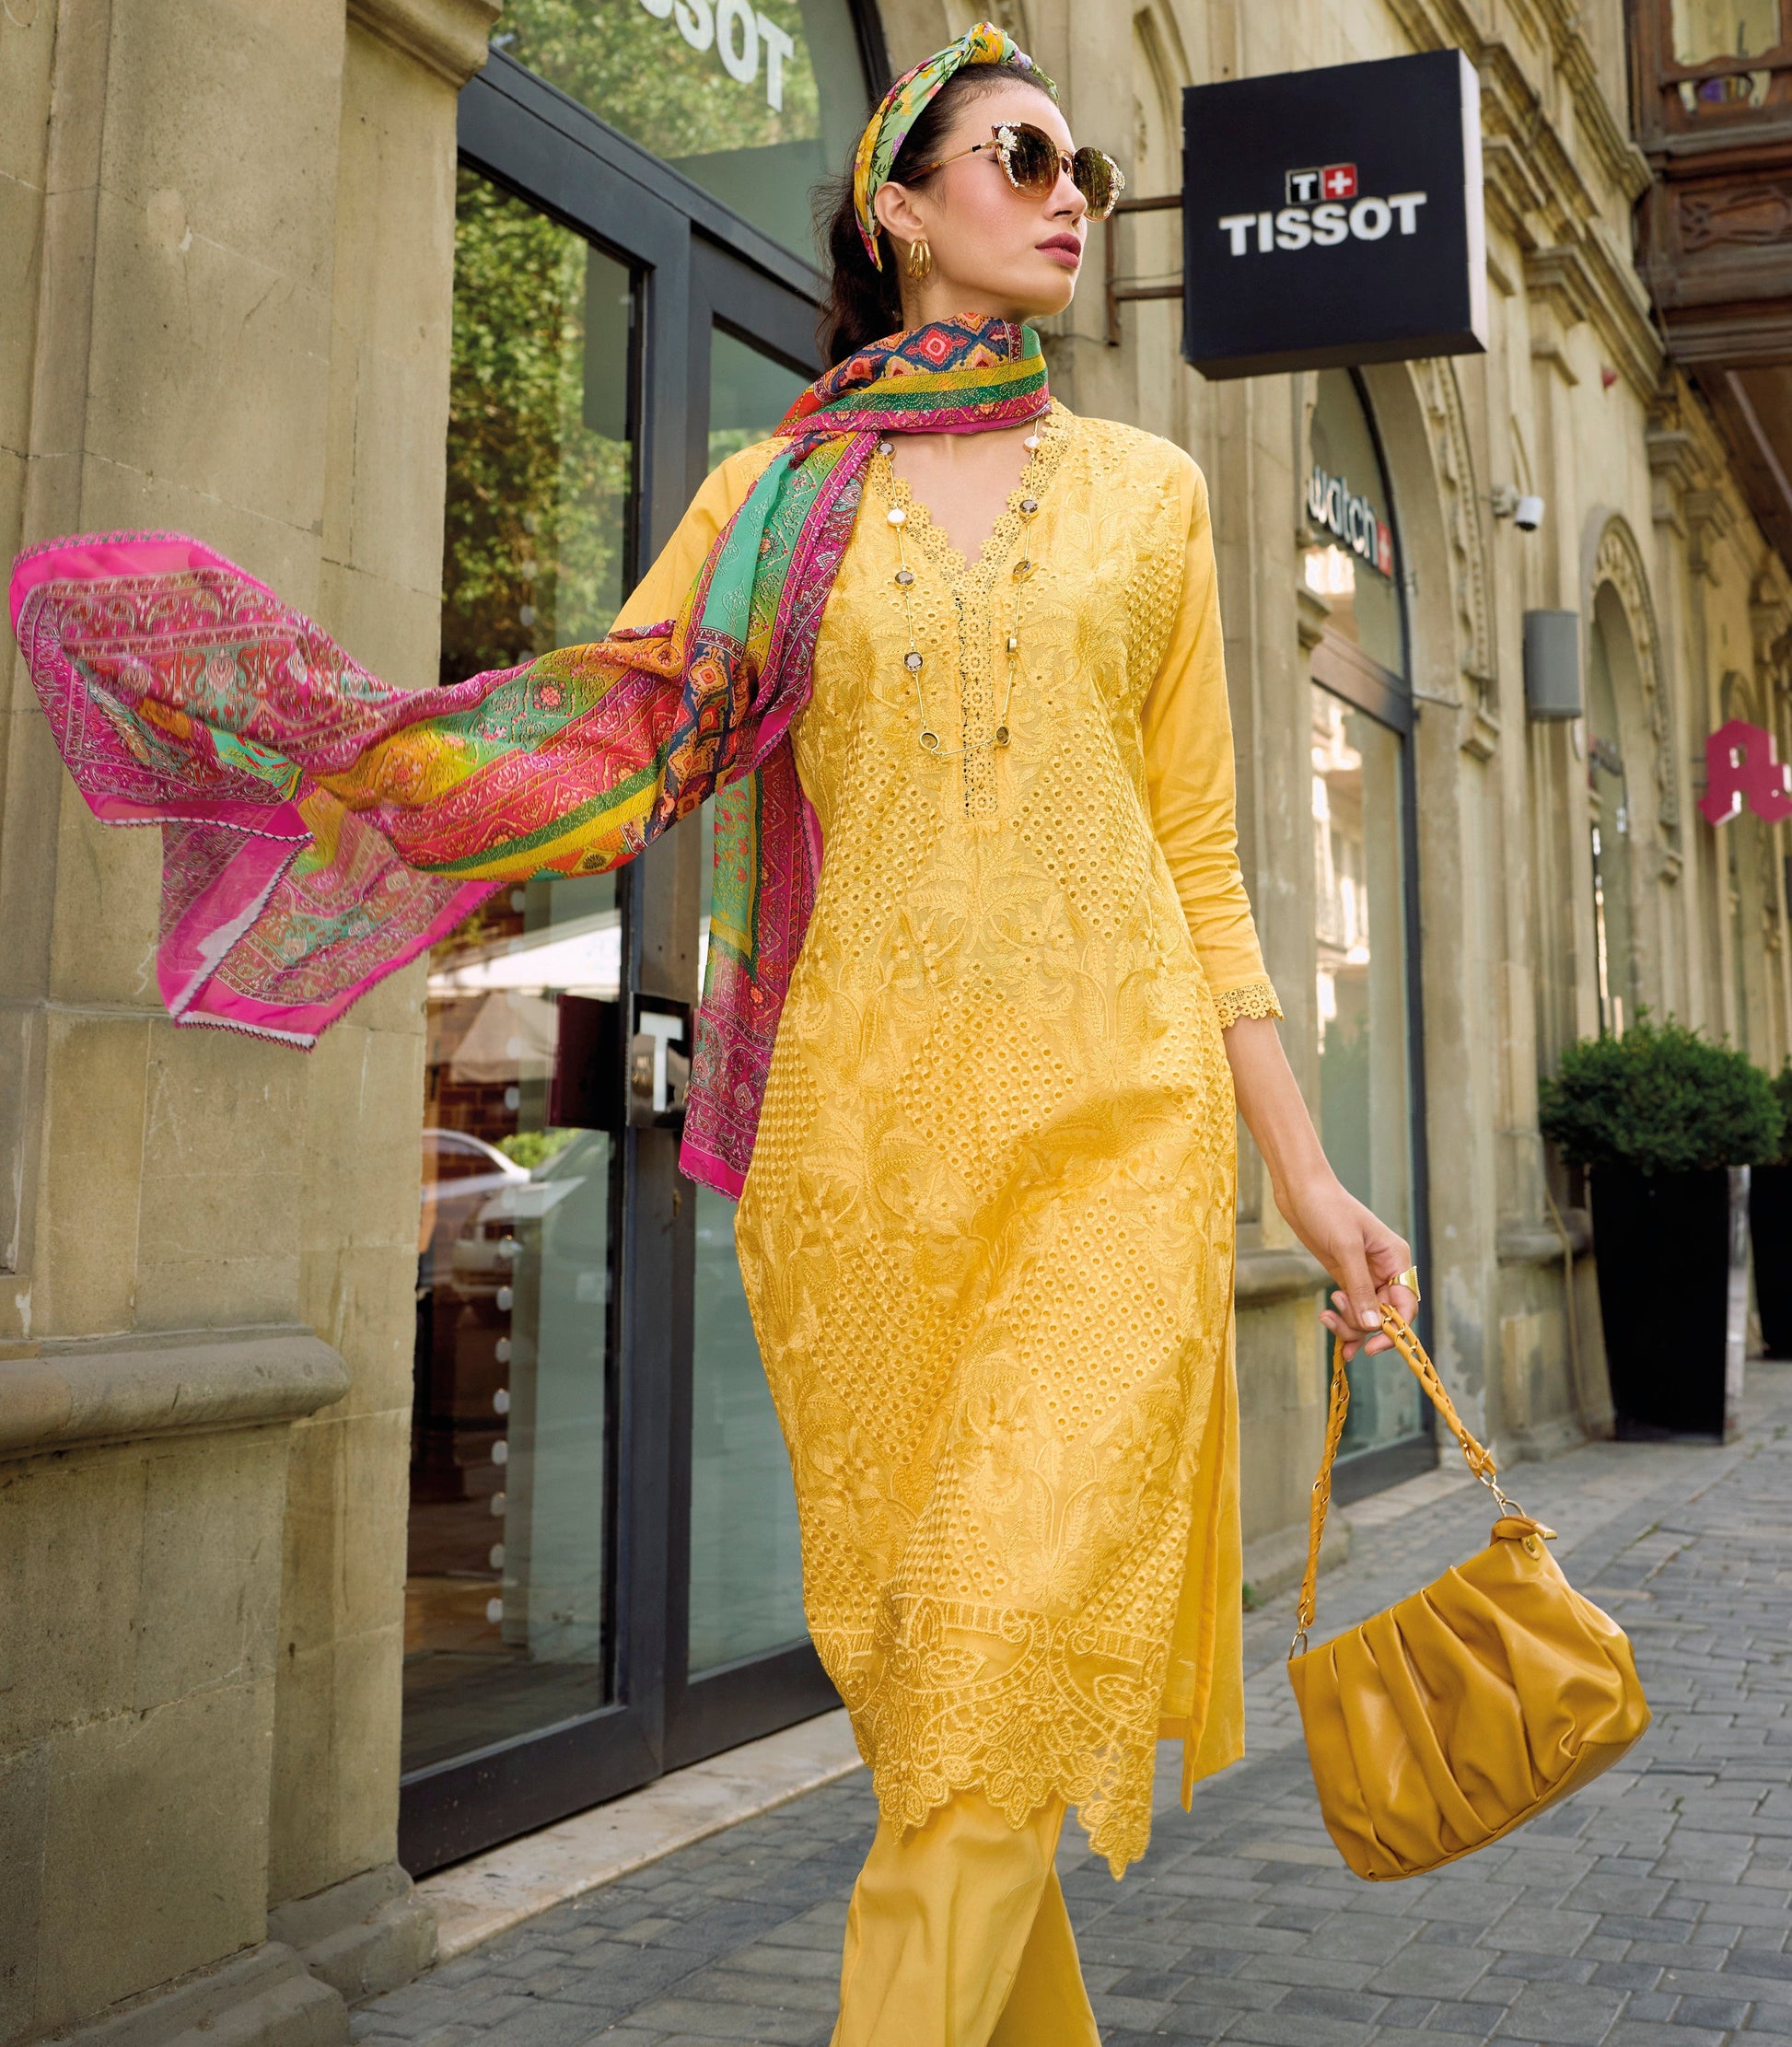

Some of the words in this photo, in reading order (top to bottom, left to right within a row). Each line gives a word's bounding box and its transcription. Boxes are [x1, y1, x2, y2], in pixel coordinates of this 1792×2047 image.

[640, 0, 795, 112] SOT
[1218, 191, 1427, 257] TISSOT
[639, 1011, 684, 1112] T
